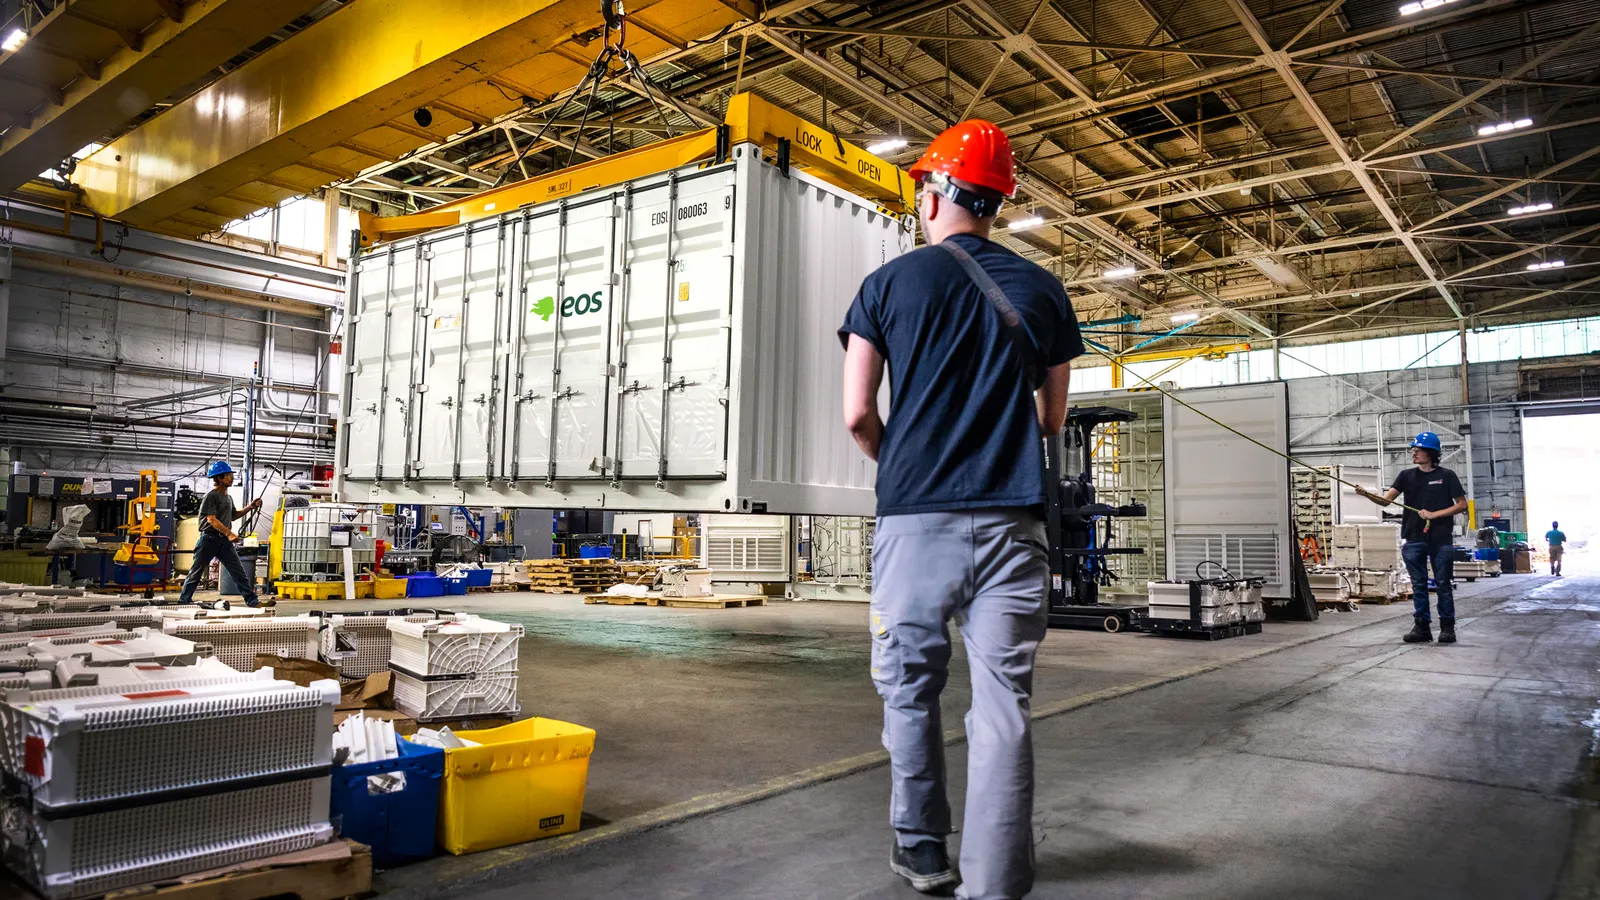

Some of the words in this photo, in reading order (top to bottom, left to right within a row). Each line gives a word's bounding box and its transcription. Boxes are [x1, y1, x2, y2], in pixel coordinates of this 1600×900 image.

[795, 127, 822, 154] LOCK
[857, 159, 881, 182] OPEN
[678, 202, 708, 221] 080063
[725, 195, 732, 210] 9
[560, 290, 603, 318] eos
[540, 816, 563, 828] ULINE
